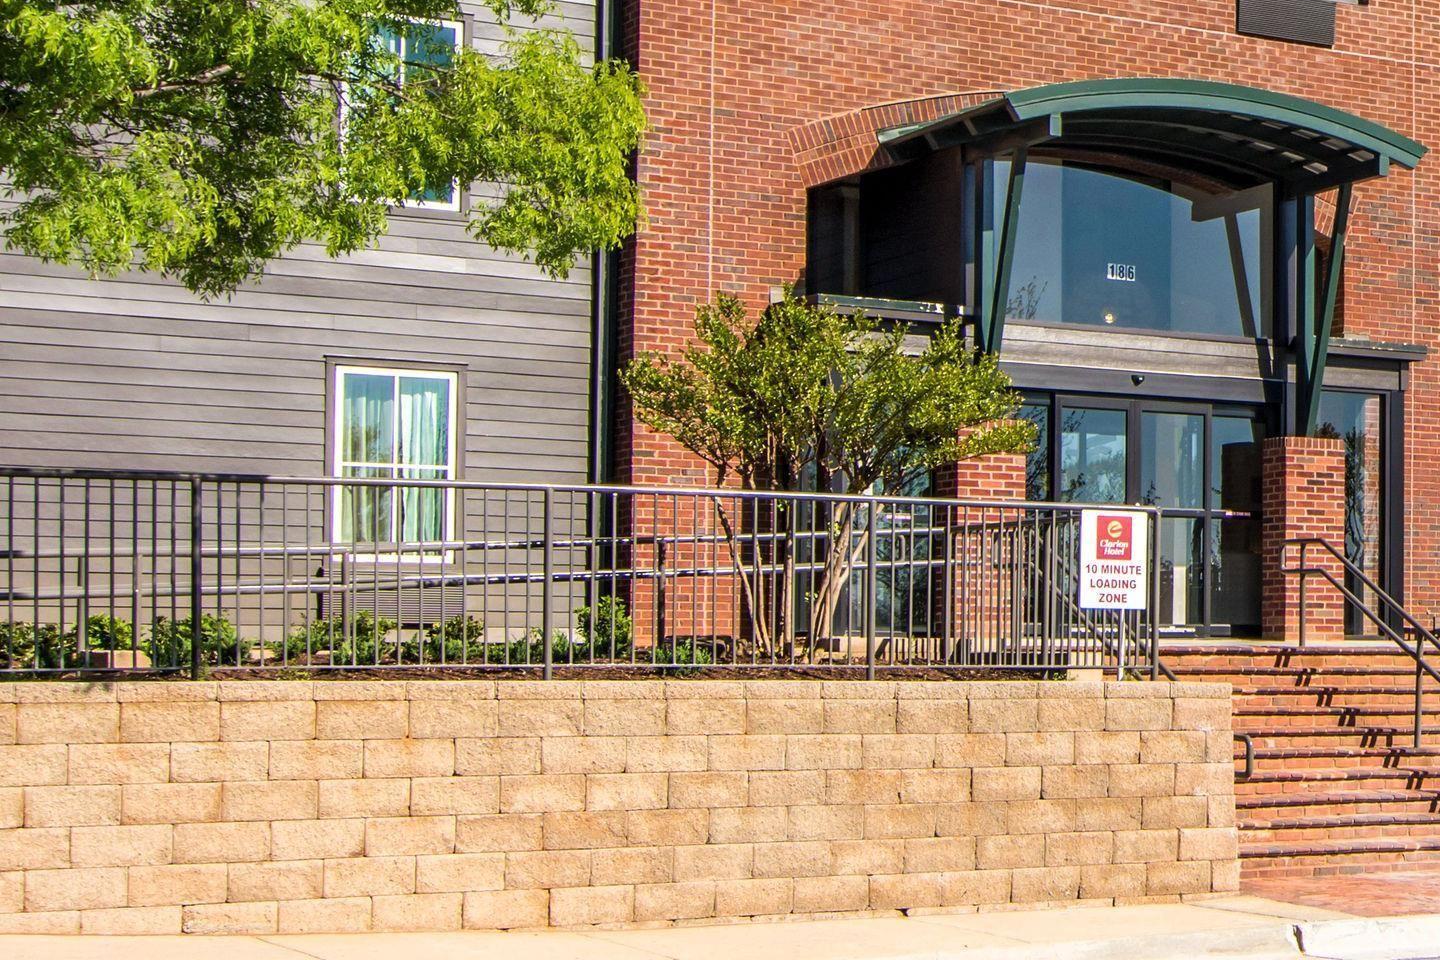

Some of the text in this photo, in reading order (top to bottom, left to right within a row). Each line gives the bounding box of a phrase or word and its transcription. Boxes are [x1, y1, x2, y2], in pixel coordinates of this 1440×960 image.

[1109, 264, 1134, 280] 186
[1100, 539, 1129, 548] Clarion
[1103, 547, 1125, 556] Hotel
[1086, 564, 1142, 575] 10 MINUTE
[1089, 578, 1137, 589] LOADING
[1098, 593, 1128, 603] ZONE
